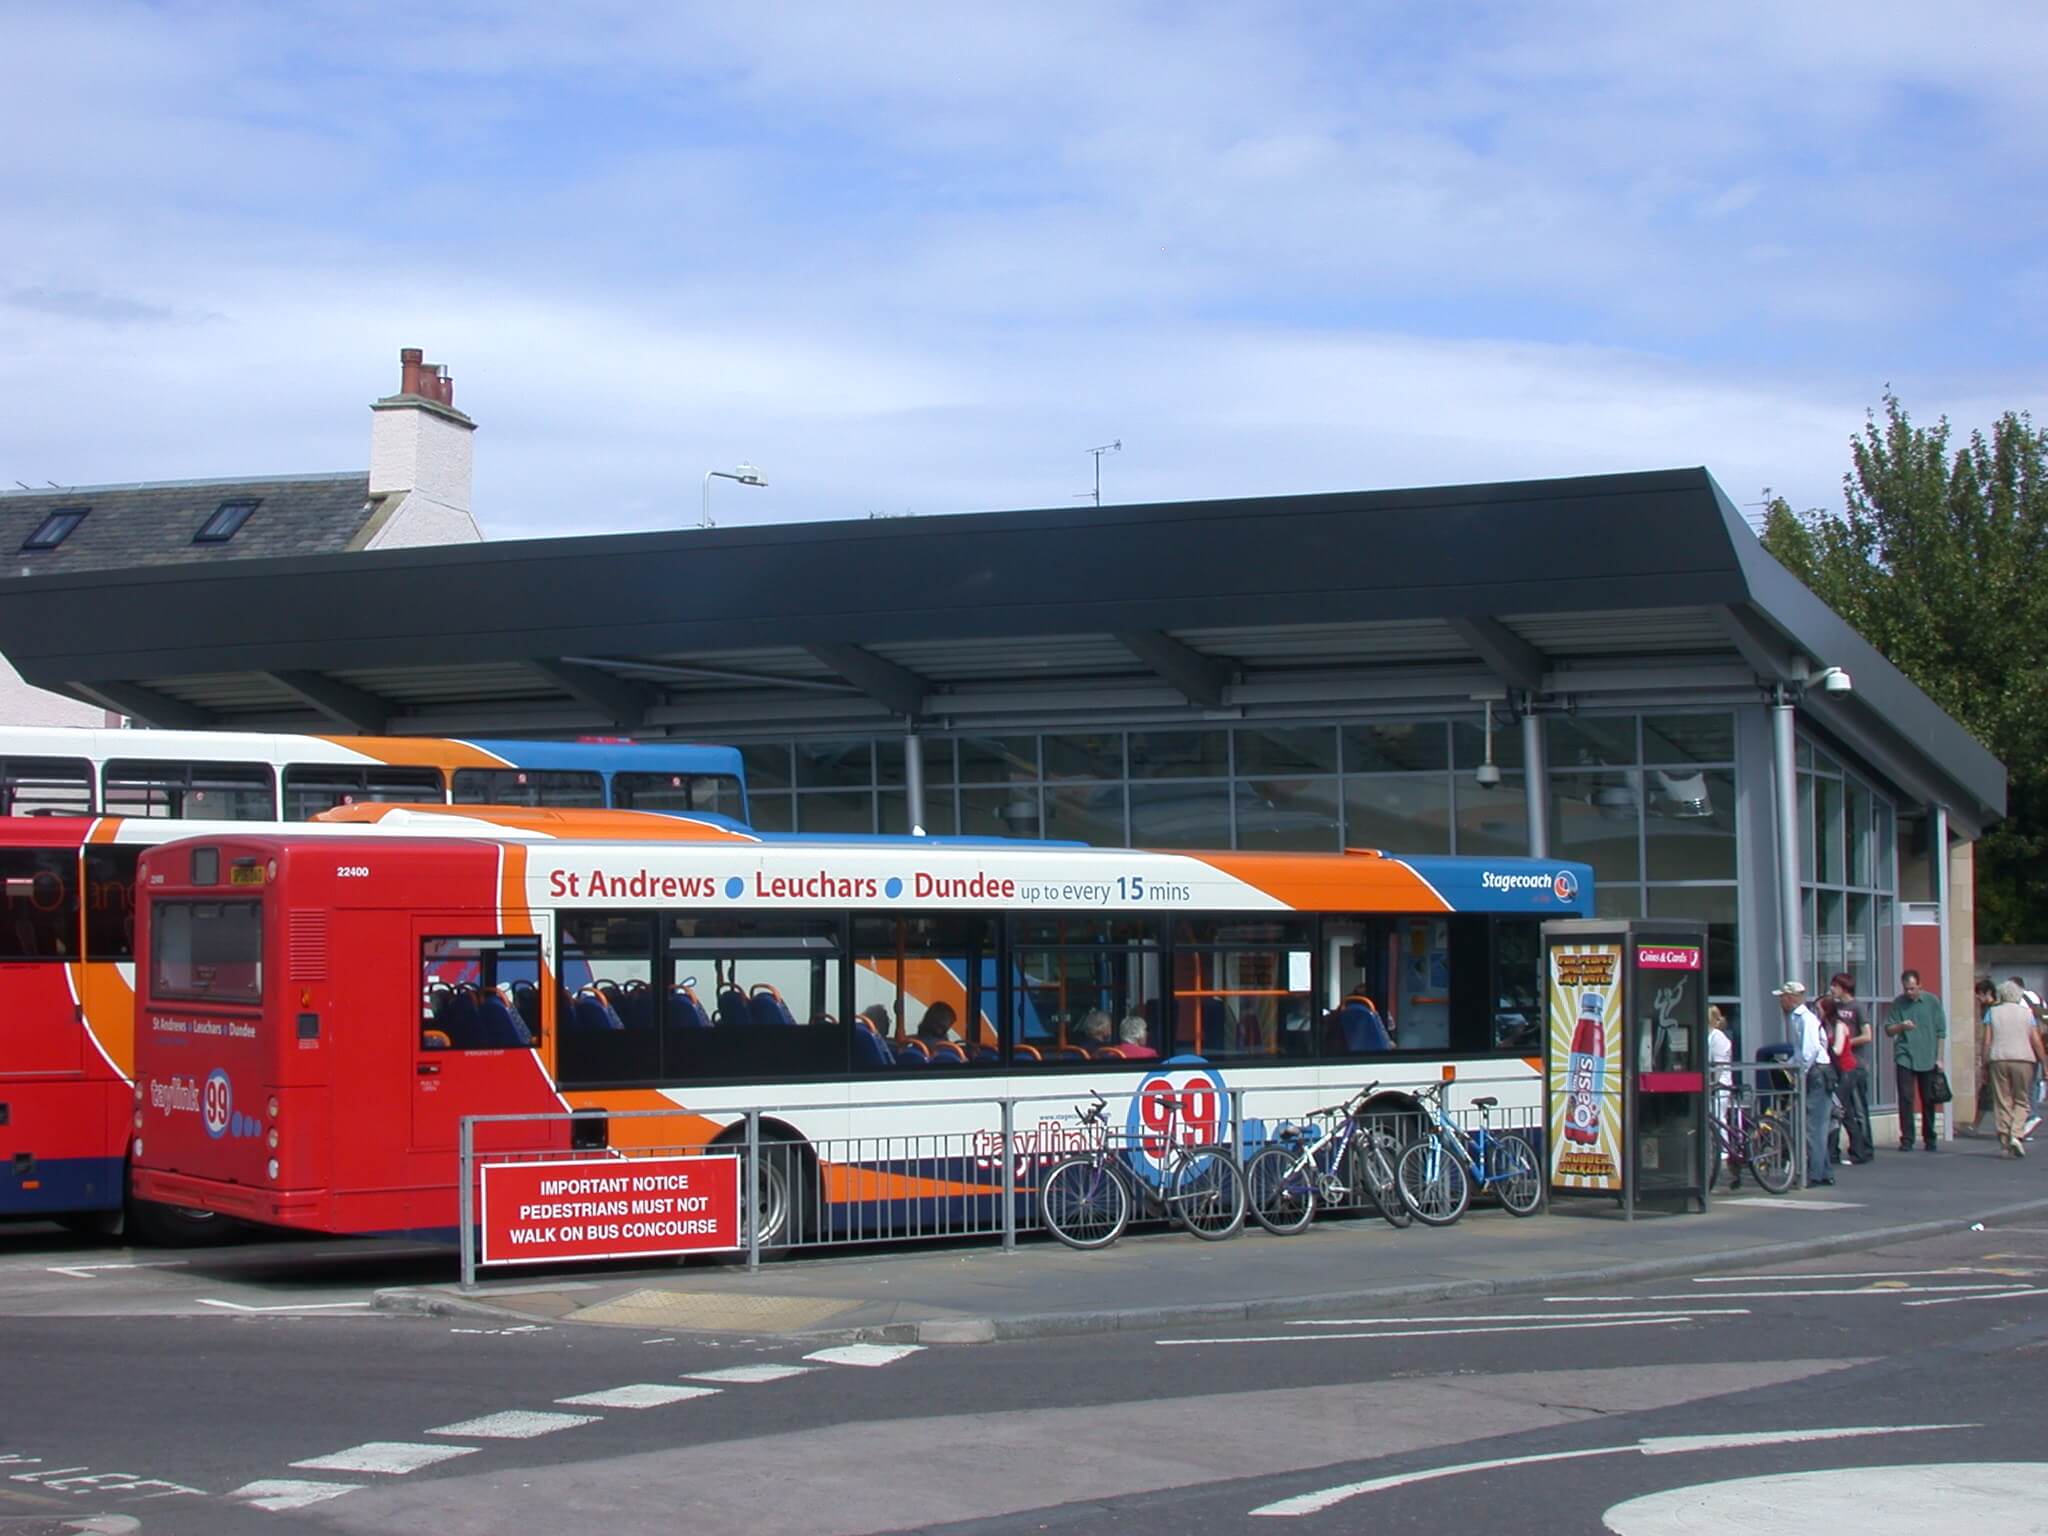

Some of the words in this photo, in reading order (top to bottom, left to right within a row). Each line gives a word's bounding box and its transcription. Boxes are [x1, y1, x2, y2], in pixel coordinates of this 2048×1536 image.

[337, 866, 370, 877] 22400
[1482, 871, 1552, 892] Stagecoach
[550, 870, 580, 897] St
[588, 869, 715, 898] Andrews
[756, 871, 877, 898] Leuchars
[914, 872, 1015, 898] Dundee
[1021, 886, 1040, 903] up
[1044, 884, 1059, 900] to
[1062, 884, 1110, 904] every
[1116, 876, 1144, 900] 15
[1150, 882, 1190, 901] mins
[1639, 950, 1659, 962] Coins
[1660, 952, 1666, 962] &
[1666, 951, 1687, 963] Cards
[153, 1017, 159, 1030] St
[160, 1018, 186, 1032] Andrews
[193, 1020, 221, 1035] Leuchars
[229, 1022, 256, 1038] Dundee
[151, 1077, 200, 1116] taylink
[207, 1080, 228, 1125] 99
[1142, 1078, 1216, 1160] 99
[541, 1178, 629, 1196] IMPORTANT
[633, 1175, 688, 1192] NOTICE
[520, 1201, 628, 1220] PEDESTRIANS
[632, 1198, 673, 1216] MUST
[677, 1196, 708, 1212] NOT
[510, 1228, 556, 1244] WALK
[560, 1226, 583, 1242] ON
[587, 1224, 618, 1240] BUS
[622, 1219, 717, 1239] CONCOURSE
